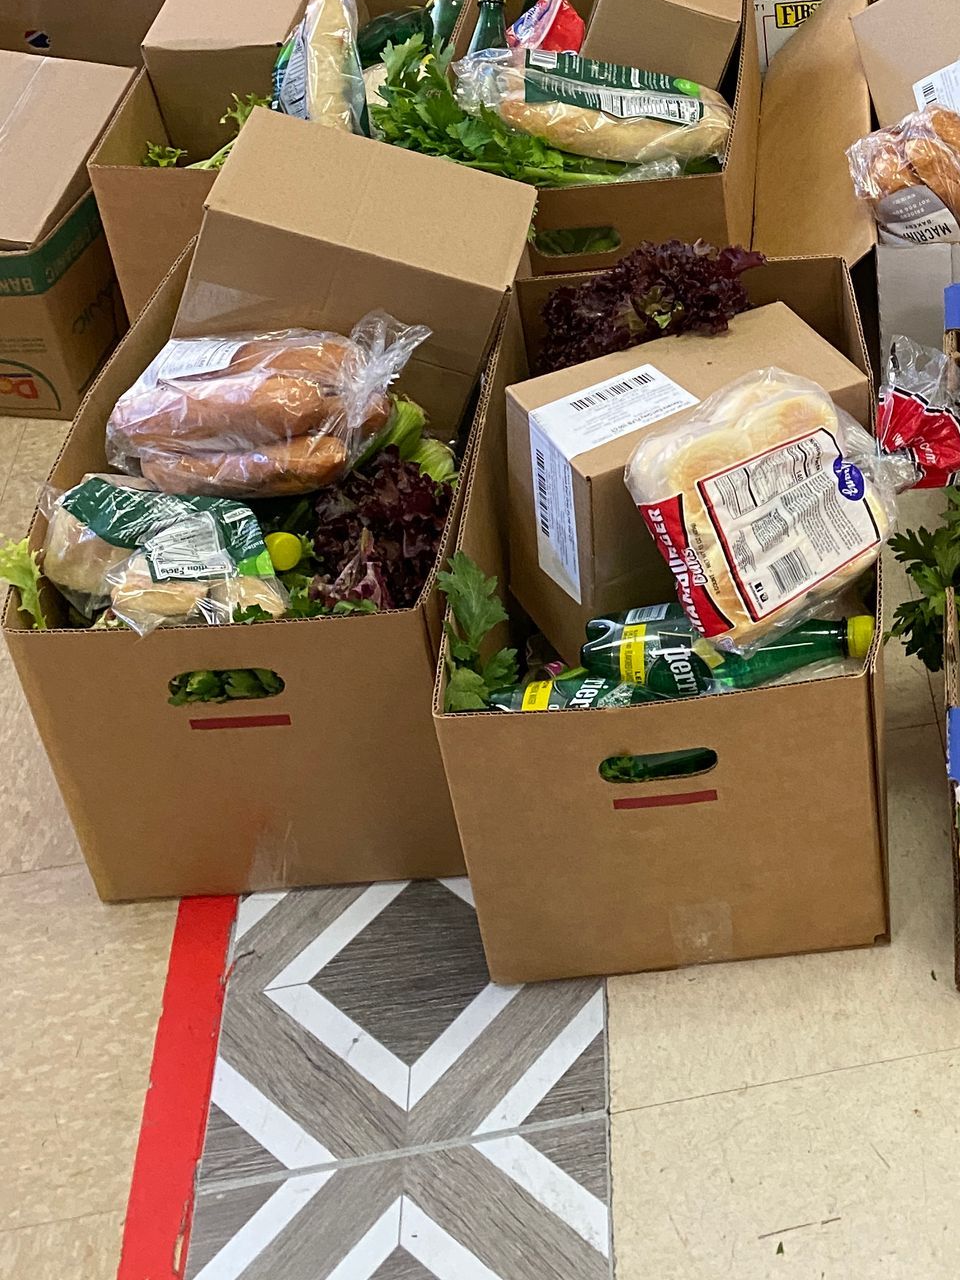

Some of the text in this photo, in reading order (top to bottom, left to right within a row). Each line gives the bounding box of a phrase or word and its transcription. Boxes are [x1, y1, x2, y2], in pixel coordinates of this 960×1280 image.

[781, 2, 822, 25] FIRS
[650, 643, 699, 696] perr
[569, 676, 609, 708] rier
